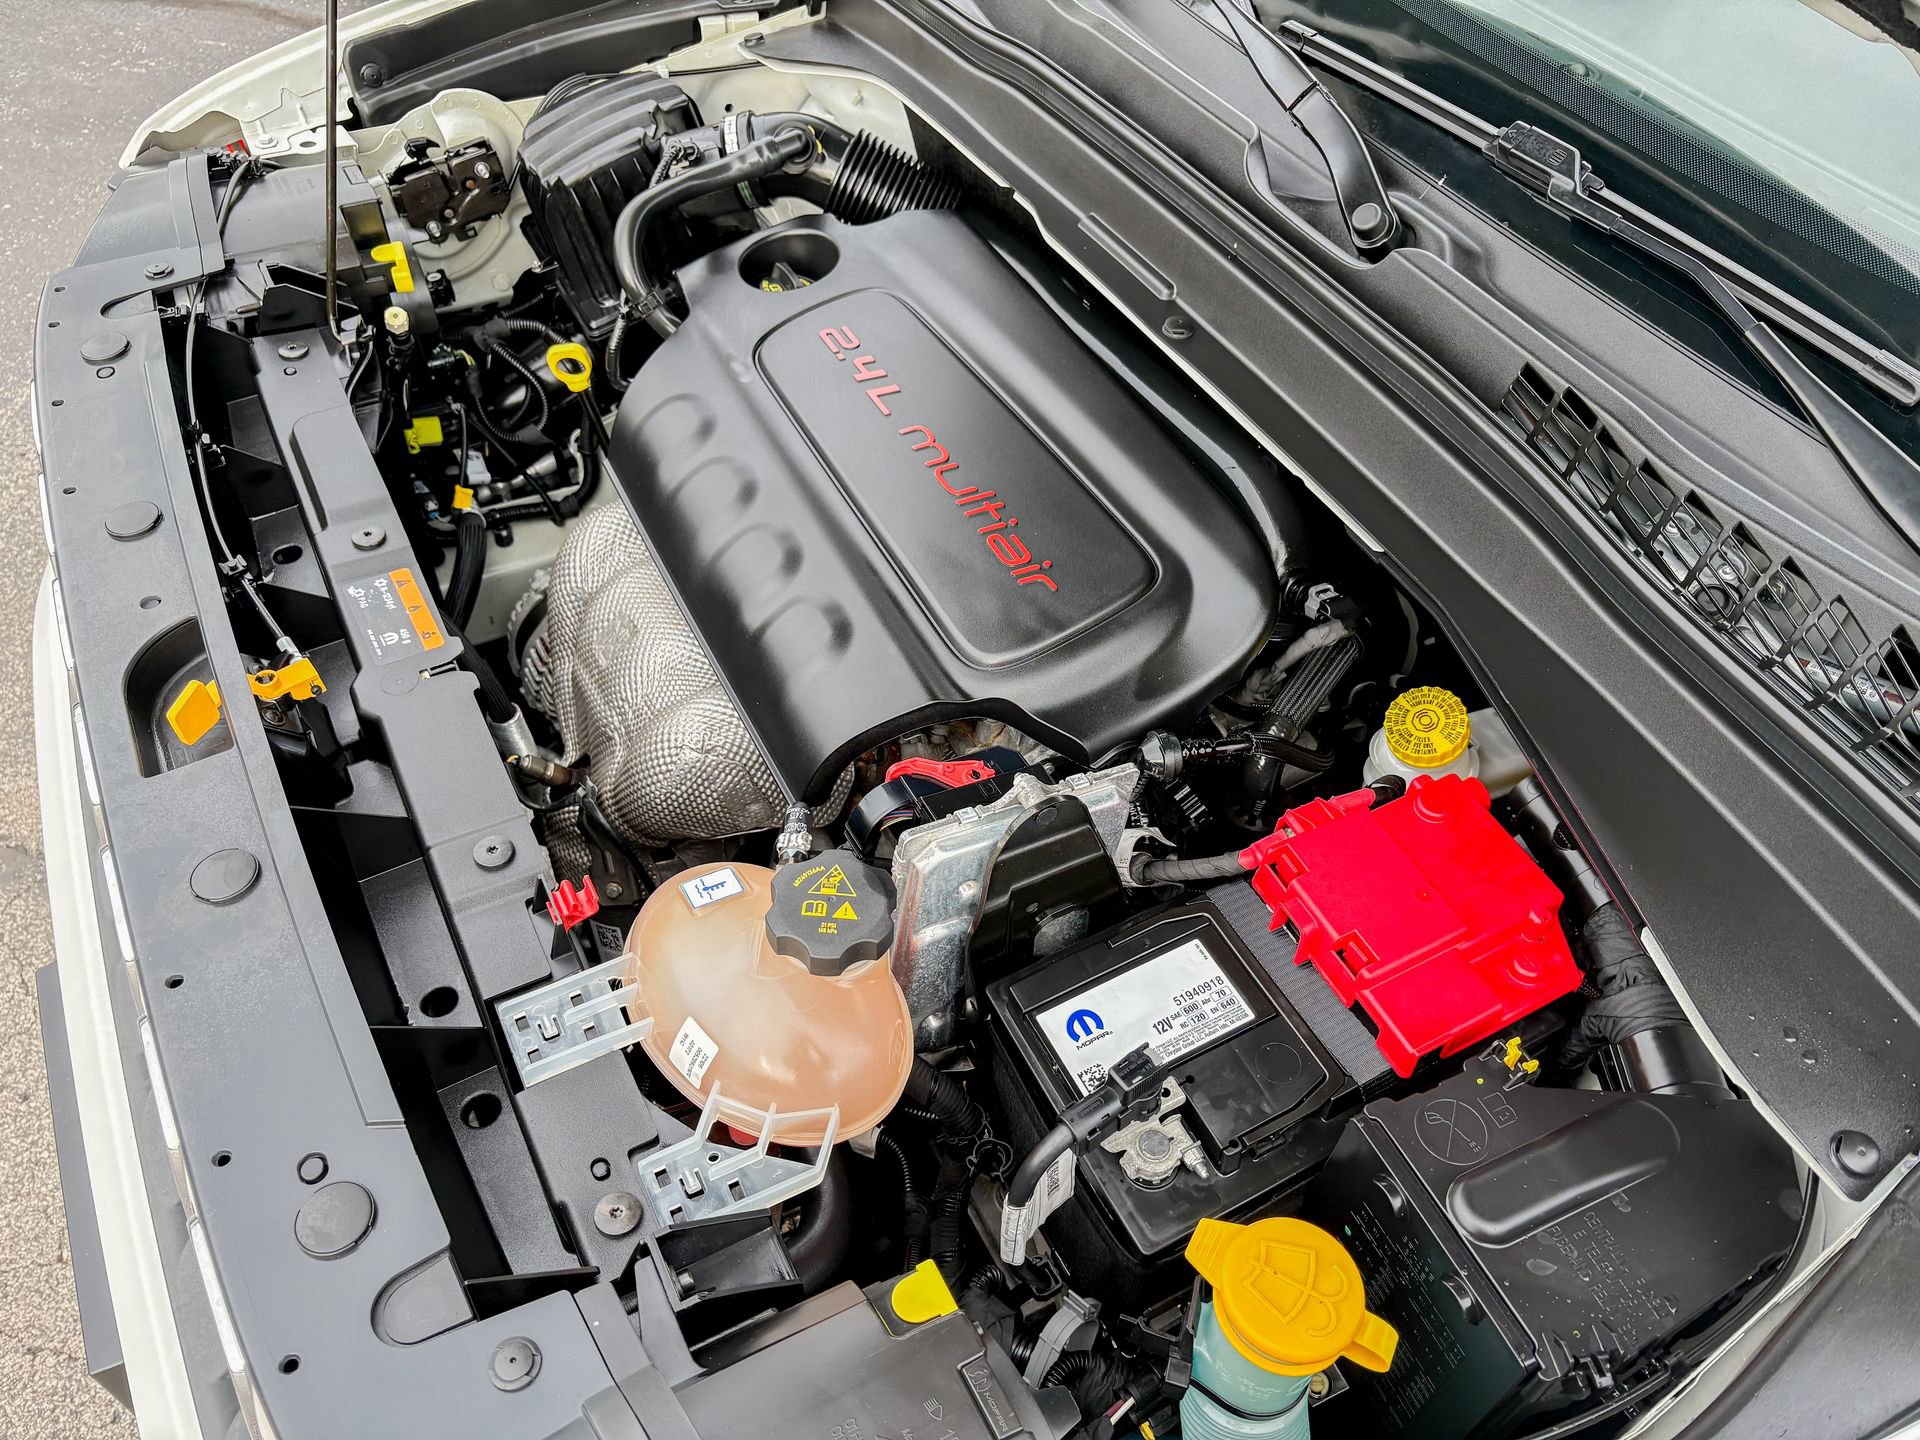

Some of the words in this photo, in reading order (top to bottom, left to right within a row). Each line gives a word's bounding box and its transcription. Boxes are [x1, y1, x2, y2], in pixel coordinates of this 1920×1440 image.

[818, 326, 901, 416] 2.4L
[899, 424, 1058, 591] multiair
[357, 596, 369, 609] PAG
[1393, 739, 1409, 751] SEALED
[1402, 728, 1414, 738] CLEAN
[1172, 975, 1225, 1006] 51940918
[1152, 1017, 1174, 1035] 12V
[1170, 1011, 1183, 1021] SAE
[1183, 1003, 1199, 1015] 600
[1215, 989, 1227, 998] 70
[1190, 1012, 1207, 1023] 120
[1210, 1006, 1219, 1015] EN
[1220, 998, 1236, 1010] 640
[1076, 1030, 1110, 1050] MOPAR
[984, 1393, 1008, 1431] MOPAR
